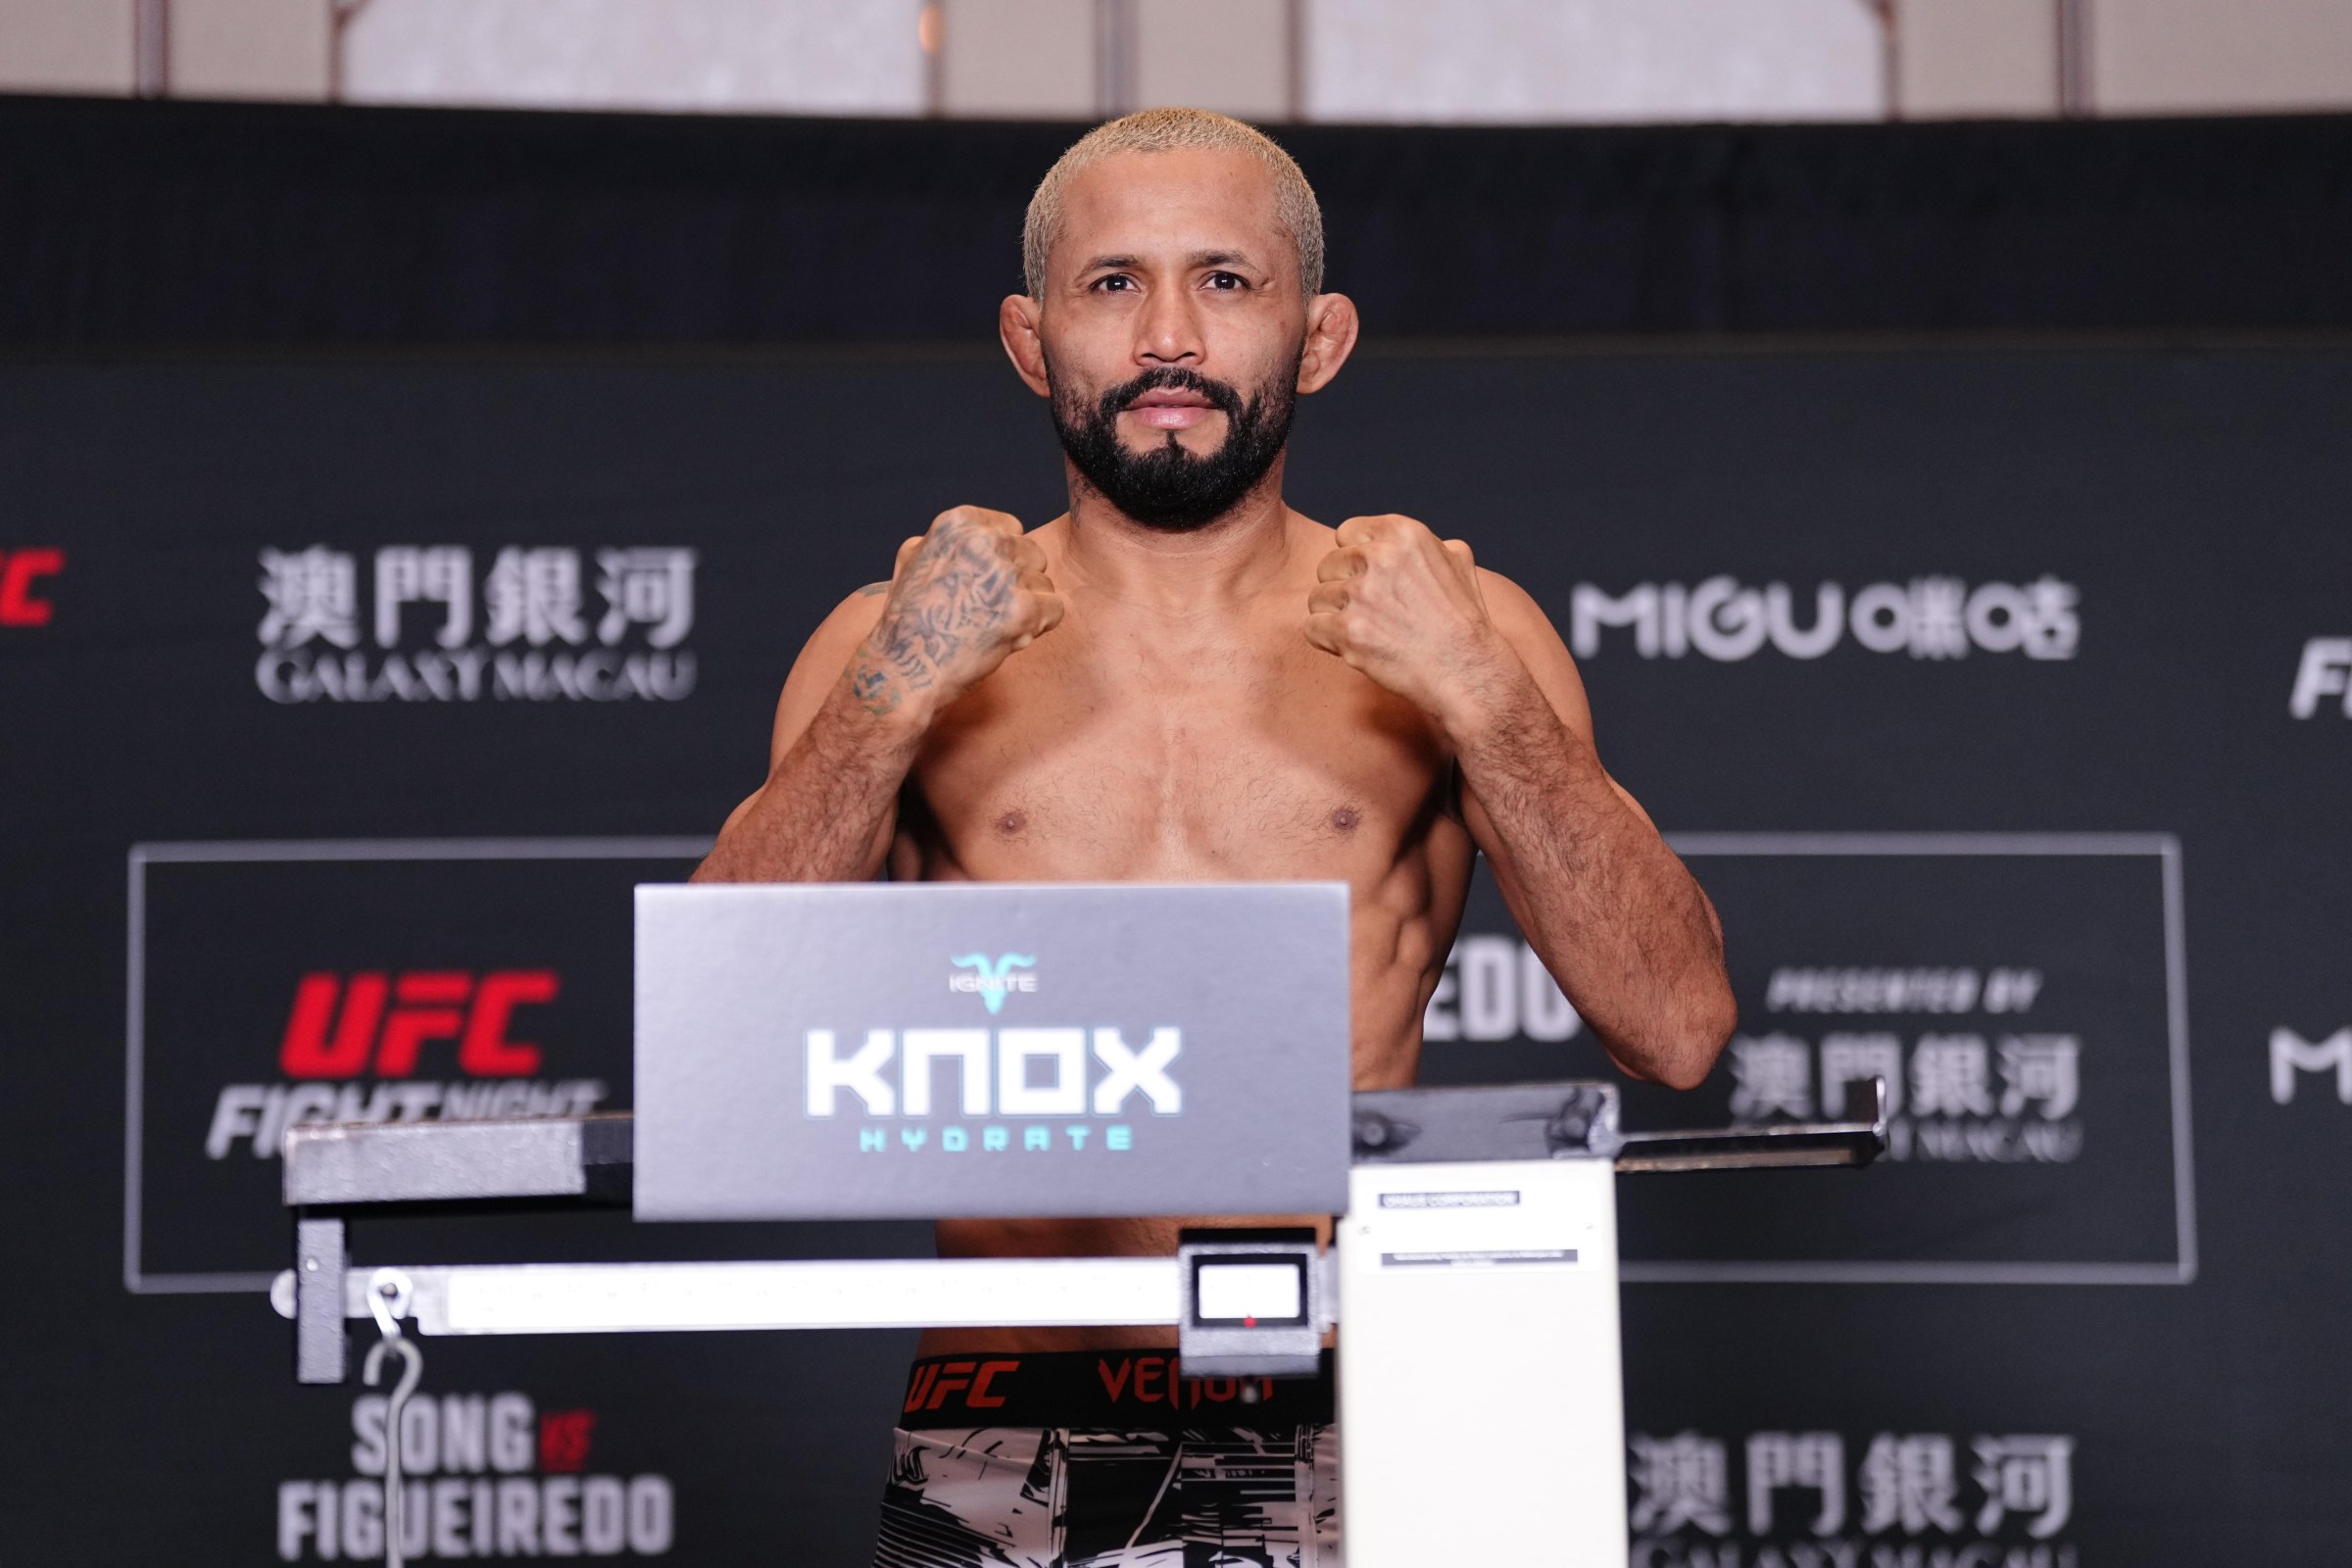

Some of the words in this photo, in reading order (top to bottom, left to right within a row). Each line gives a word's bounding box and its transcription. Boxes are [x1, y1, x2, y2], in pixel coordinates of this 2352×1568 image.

[258, 543, 700, 650] 澳門銀河
[1570, 575, 1844, 662] MIGU
[255, 646, 490, 705] GALAXY
[278, 969, 561, 1078] UFC
[950, 972, 1038, 994] IGNITE
[858, 1124, 1133, 1153] HYDRATE
[904, 1360, 1020, 1414] UFC
[350, 1392, 536, 1476] SONG
[277, 1474, 673, 1560] FIGUEIREDO
